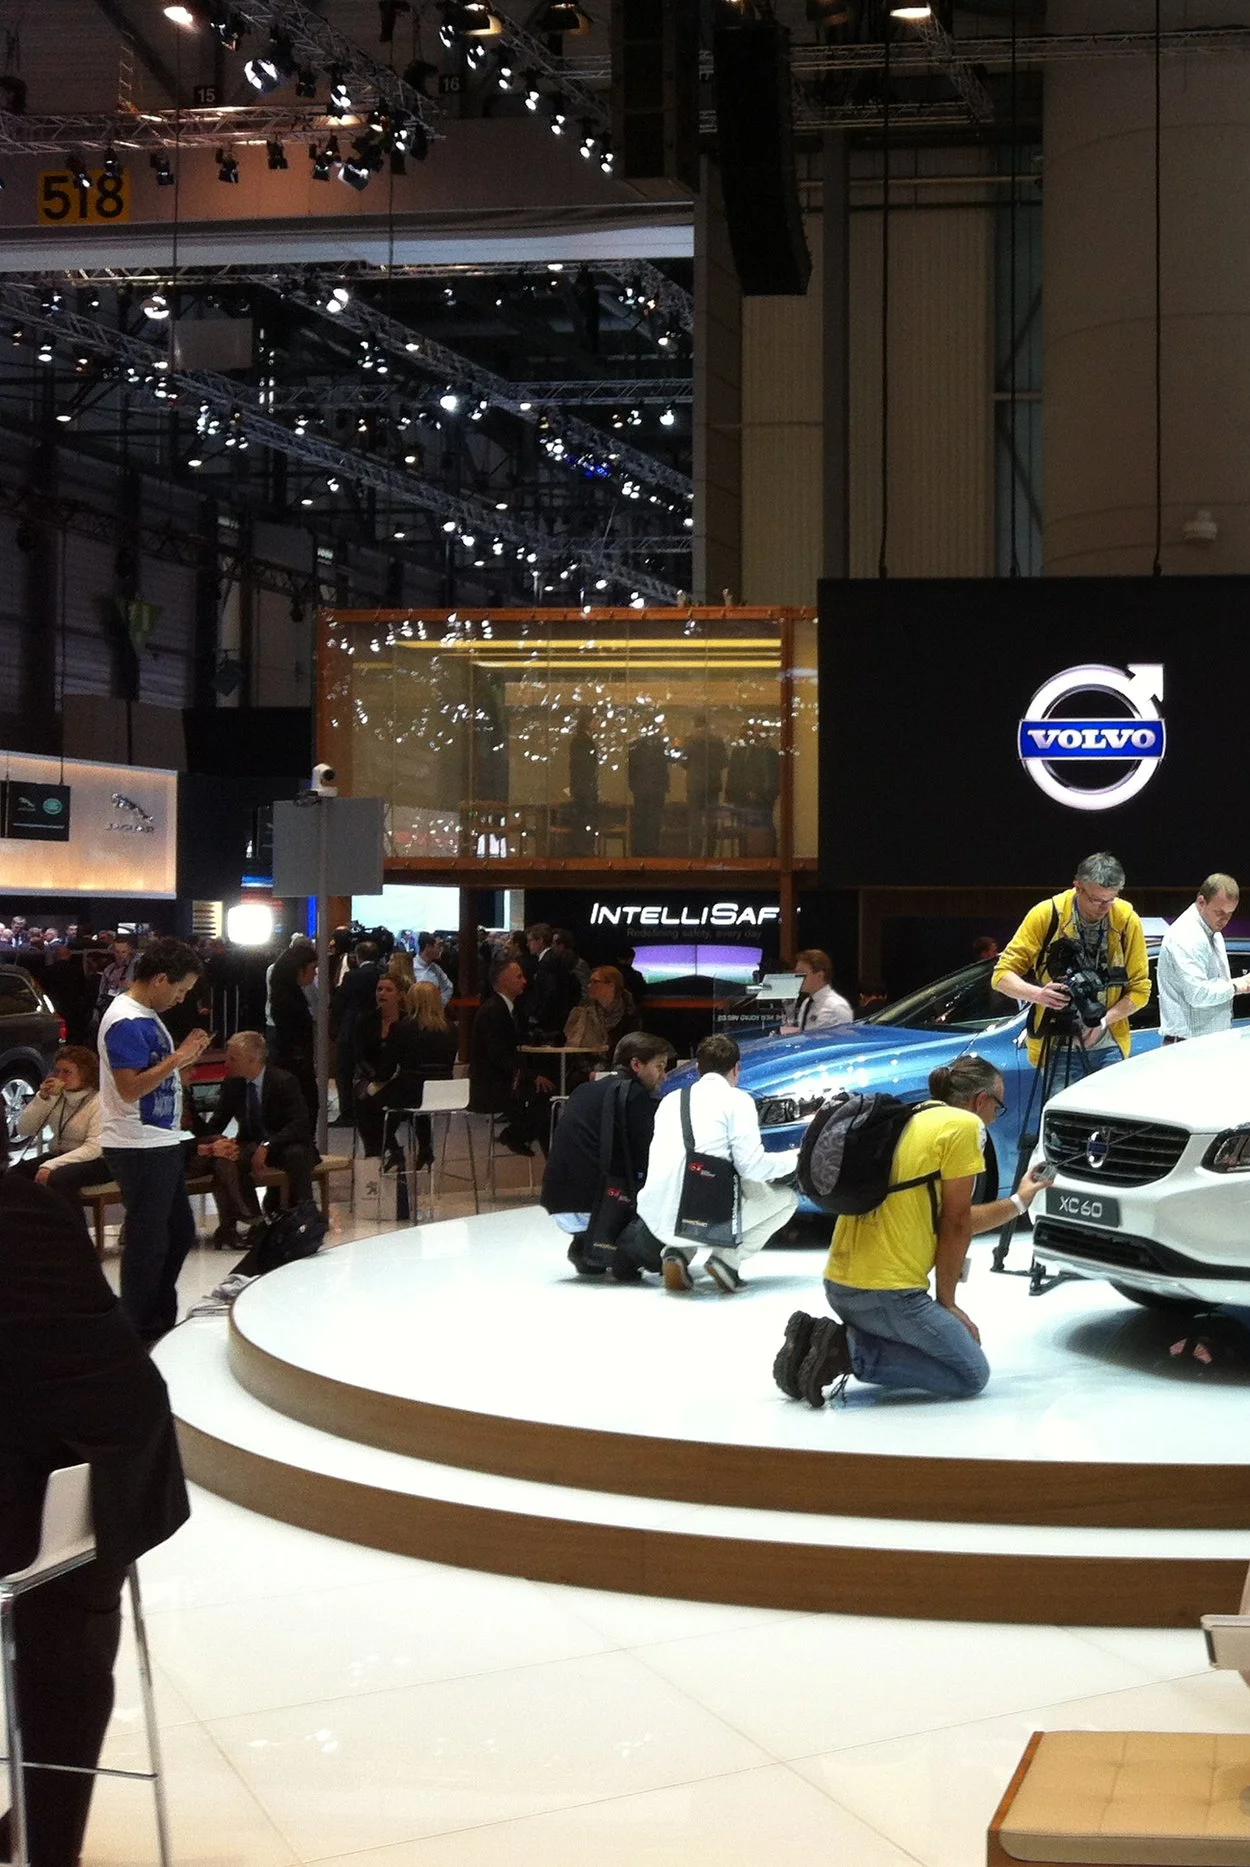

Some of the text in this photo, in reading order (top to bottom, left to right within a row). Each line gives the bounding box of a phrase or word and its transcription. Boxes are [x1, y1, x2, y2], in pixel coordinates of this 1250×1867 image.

[444, 77, 460, 92] 16
[198, 88, 216, 103] 15
[43, 175, 124, 220] 518
[1027, 728, 1156, 749] VOLVO
[1059, 1195, 1103, 1218] XC60
